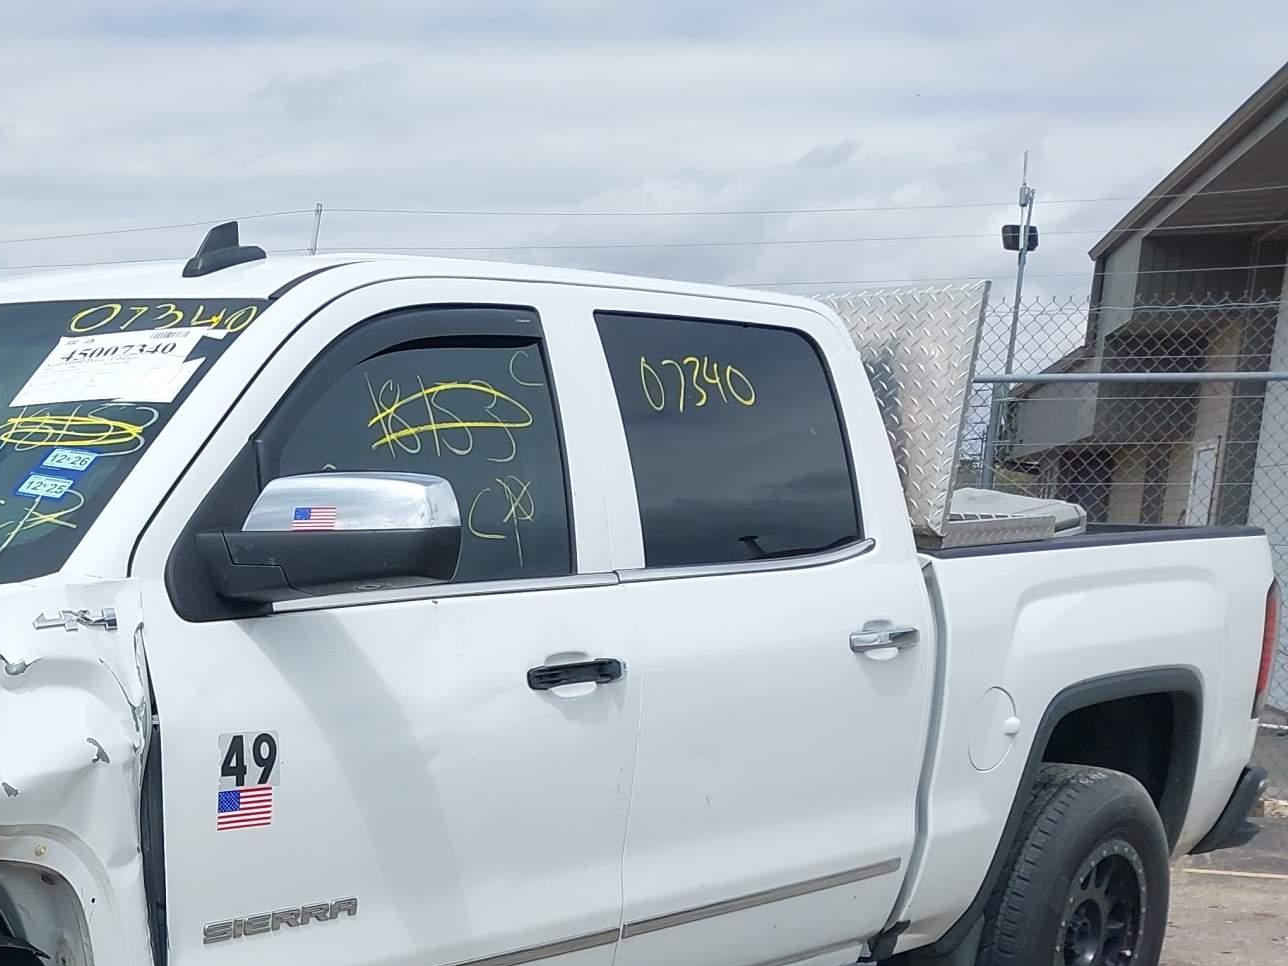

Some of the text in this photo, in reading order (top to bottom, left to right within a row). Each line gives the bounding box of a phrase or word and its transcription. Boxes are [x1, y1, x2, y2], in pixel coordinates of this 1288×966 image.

[61, 342, 177, 362] 45007340
[640, 356, 755, 413] 07340
[221, 732, 278, 787] 49
[203, 897, 358, 945] SIERRA
